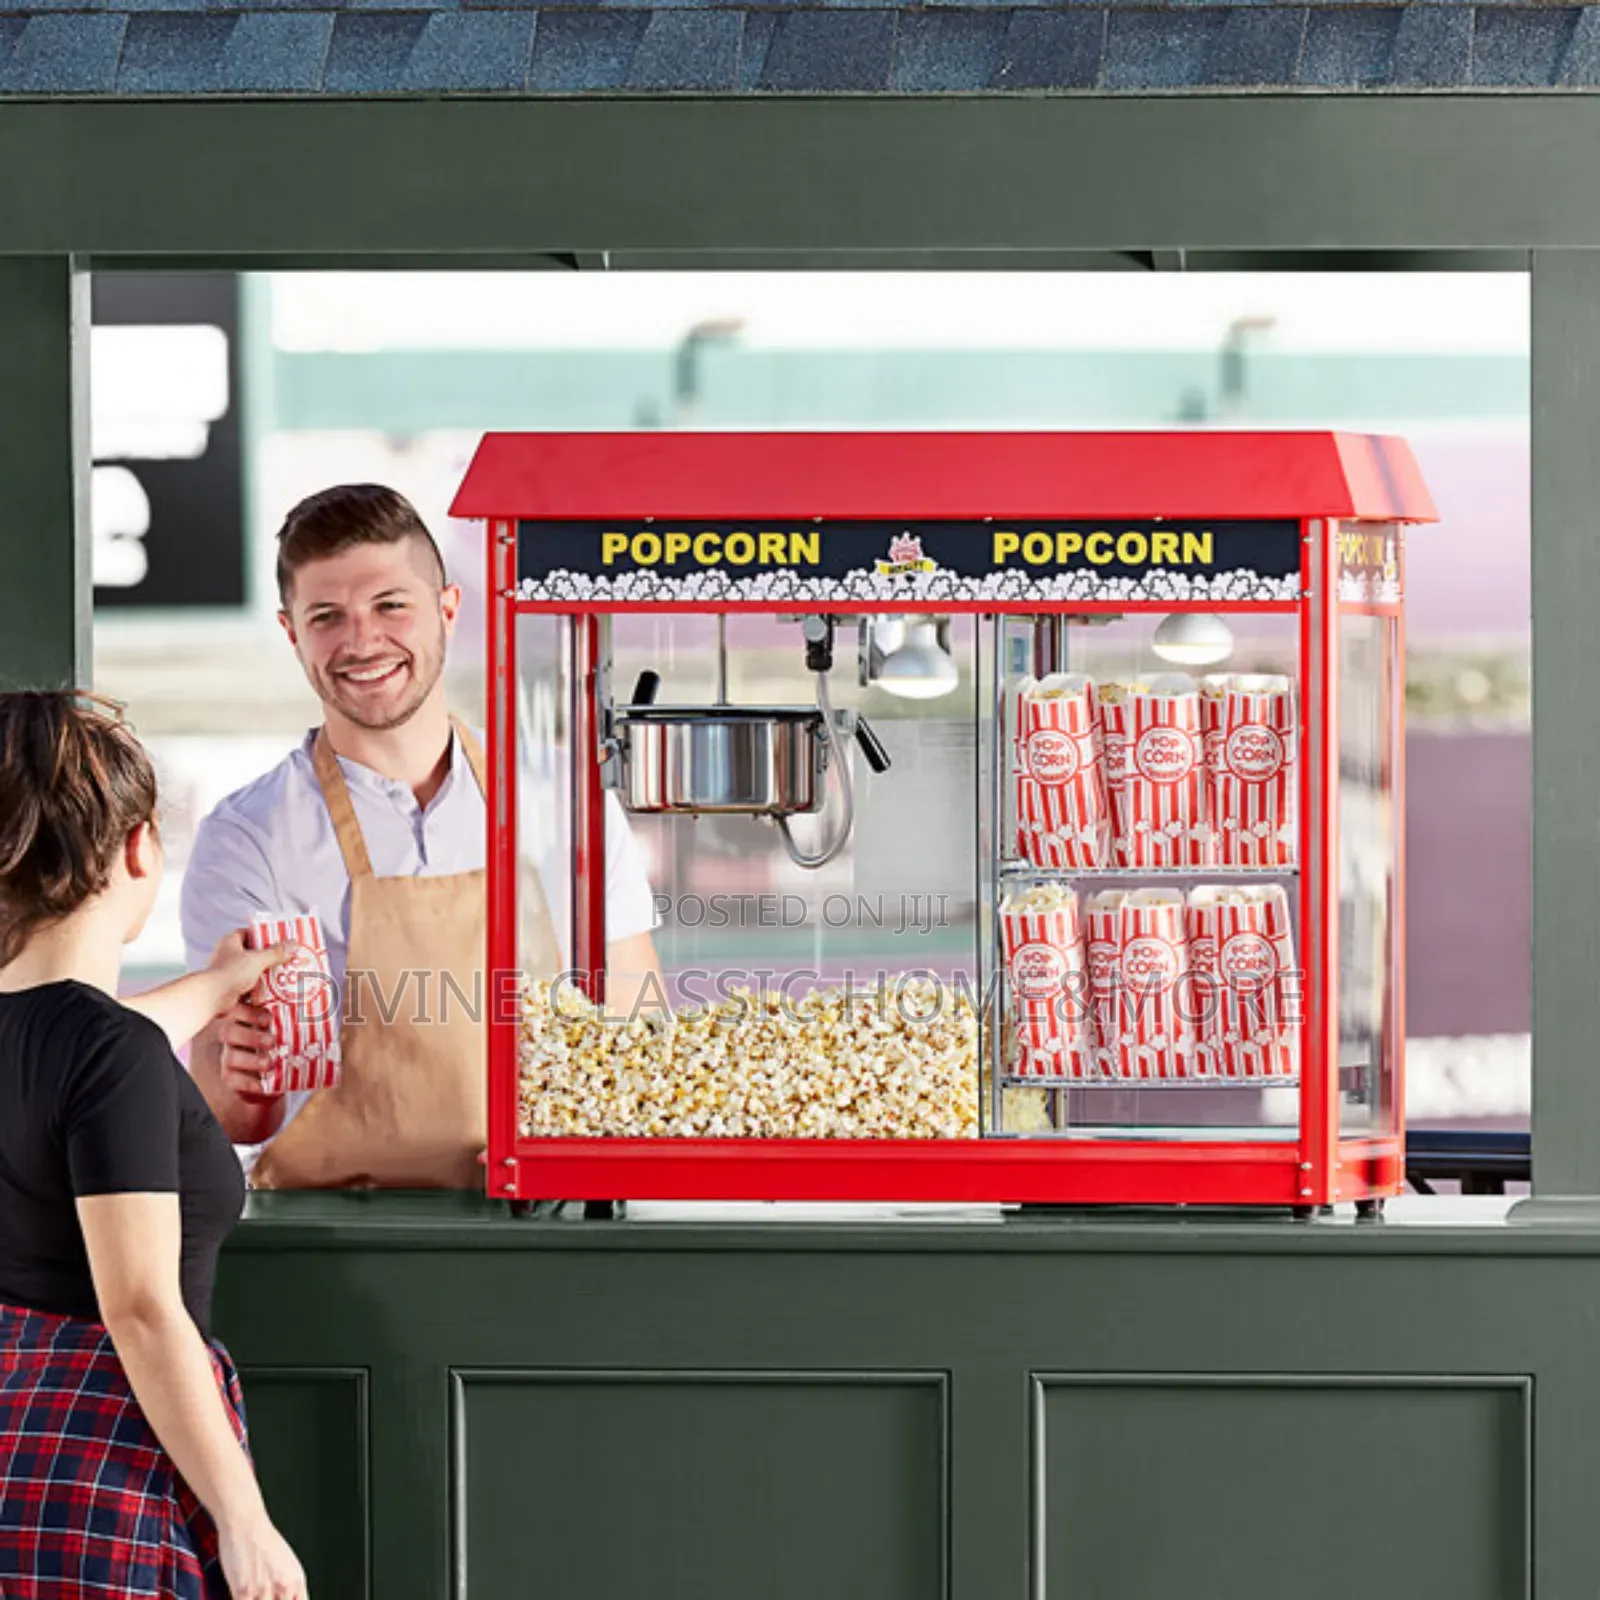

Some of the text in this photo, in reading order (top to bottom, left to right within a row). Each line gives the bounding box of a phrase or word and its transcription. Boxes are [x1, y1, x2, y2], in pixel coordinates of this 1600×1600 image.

[602, 532, 820, 565] POPCORN
[993, 532, 1213, 564] POPCORN
[1150, 736, 1180, 749] POP
[1240, 732, 1271, 745] POP
[1031, 752, 1073, 768] CORN
[1143, 748, 1185, 764] CORN
[1232, 746, 1276, 763] CORN
[1127, 960, 1169, 974] CORN
[1227, 957, 1270, 972] CORN
